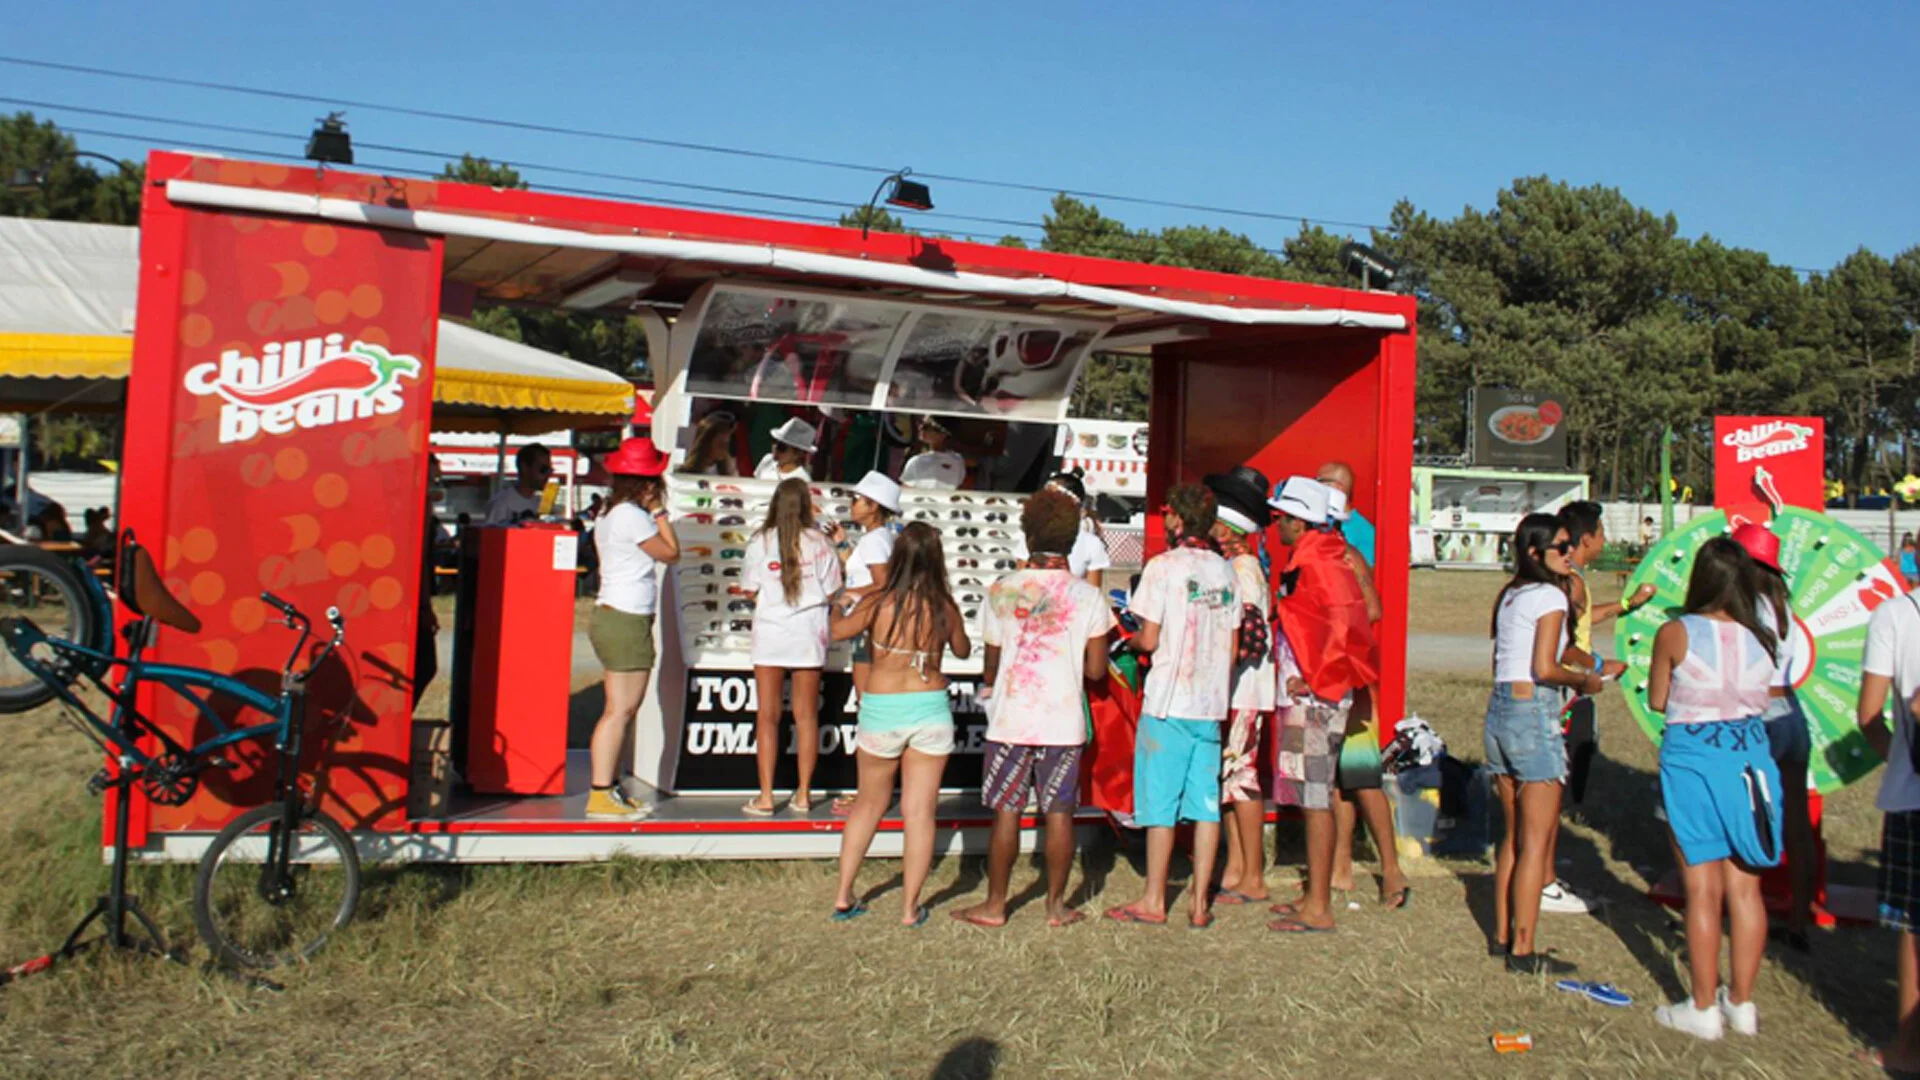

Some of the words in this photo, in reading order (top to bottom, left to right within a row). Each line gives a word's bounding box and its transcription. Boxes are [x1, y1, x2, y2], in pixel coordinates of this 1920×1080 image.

[184, 333, 344, 395] chilli
[219, 382, 404, 443] beans
[1736, 437, 1808, 463] beans
